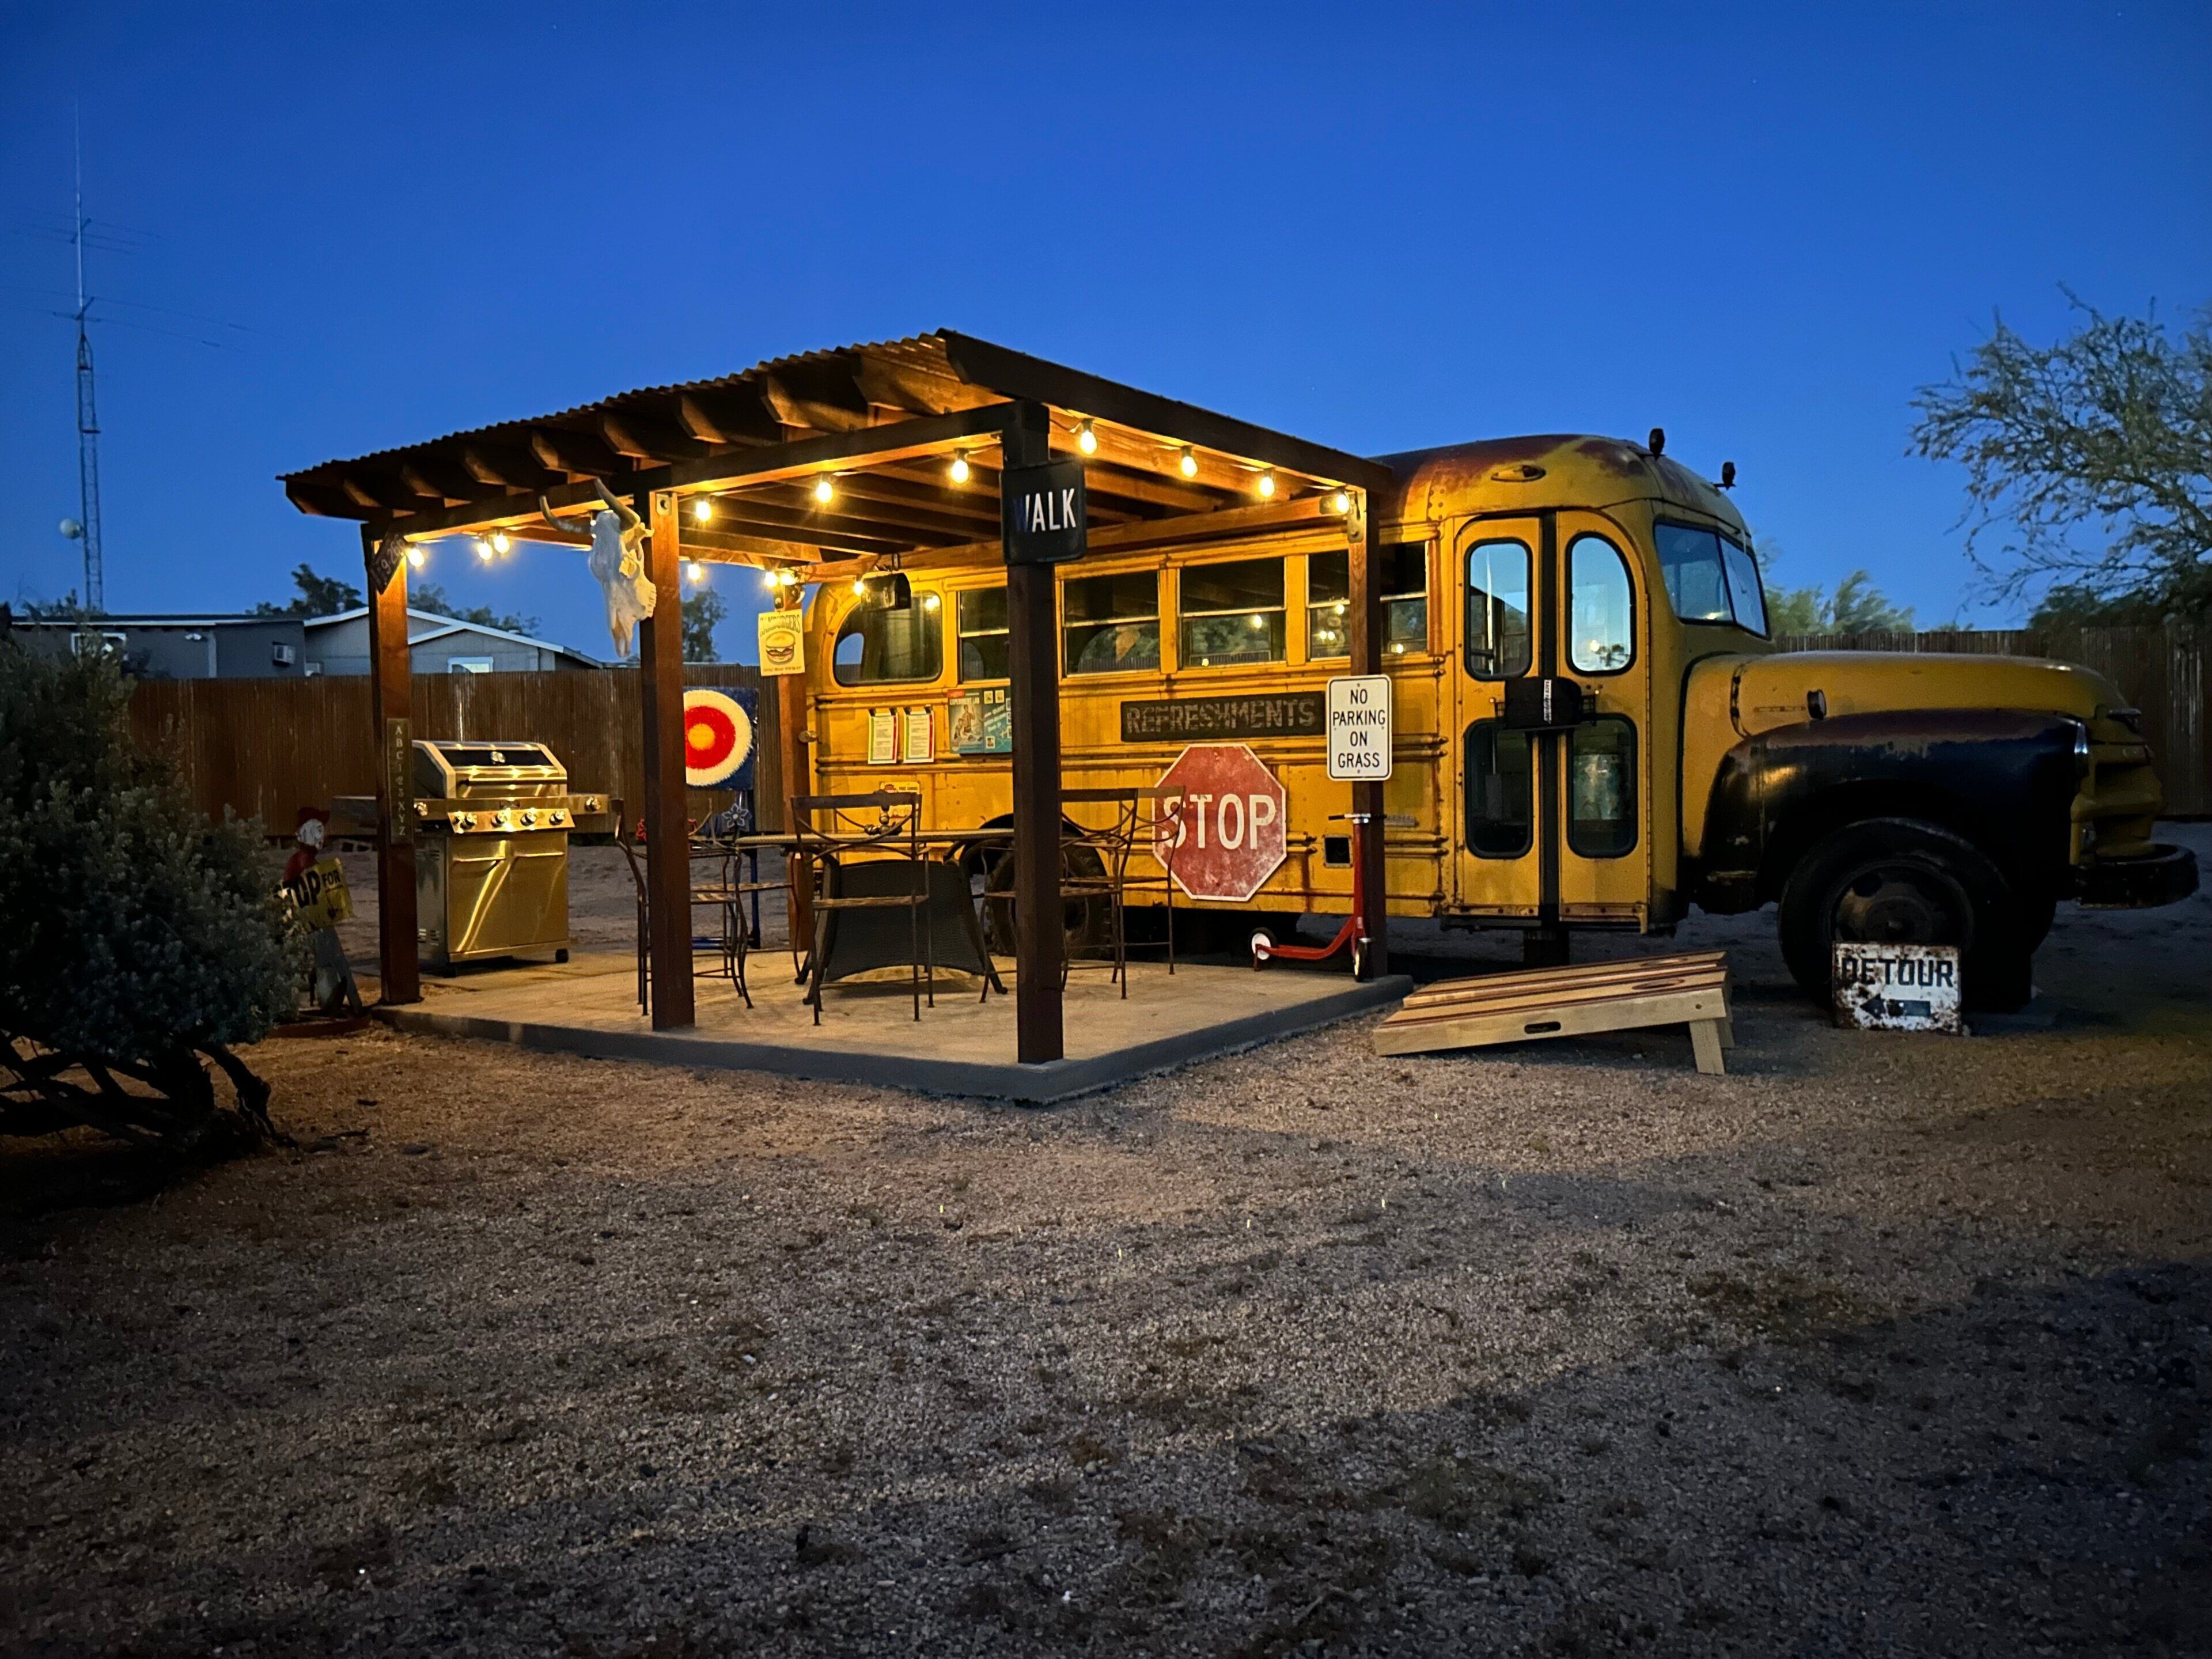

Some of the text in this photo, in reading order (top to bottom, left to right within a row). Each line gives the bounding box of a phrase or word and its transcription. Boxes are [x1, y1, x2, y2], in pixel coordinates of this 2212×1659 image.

[1350, 688, 1368, 704] NO
[1127, 699, 1316, 733] REFRESHMENTS
[1332, 709, 1385, 726] PARKING
[1350, 730, 1368, 747] ON
[1338, 752, 1380, 768] GRASS
[1161, 793, 1275, 850] STOP
[274, 869, 341, 908] TOP FOR
[1842, 957, 1953, 987] DETOUR
